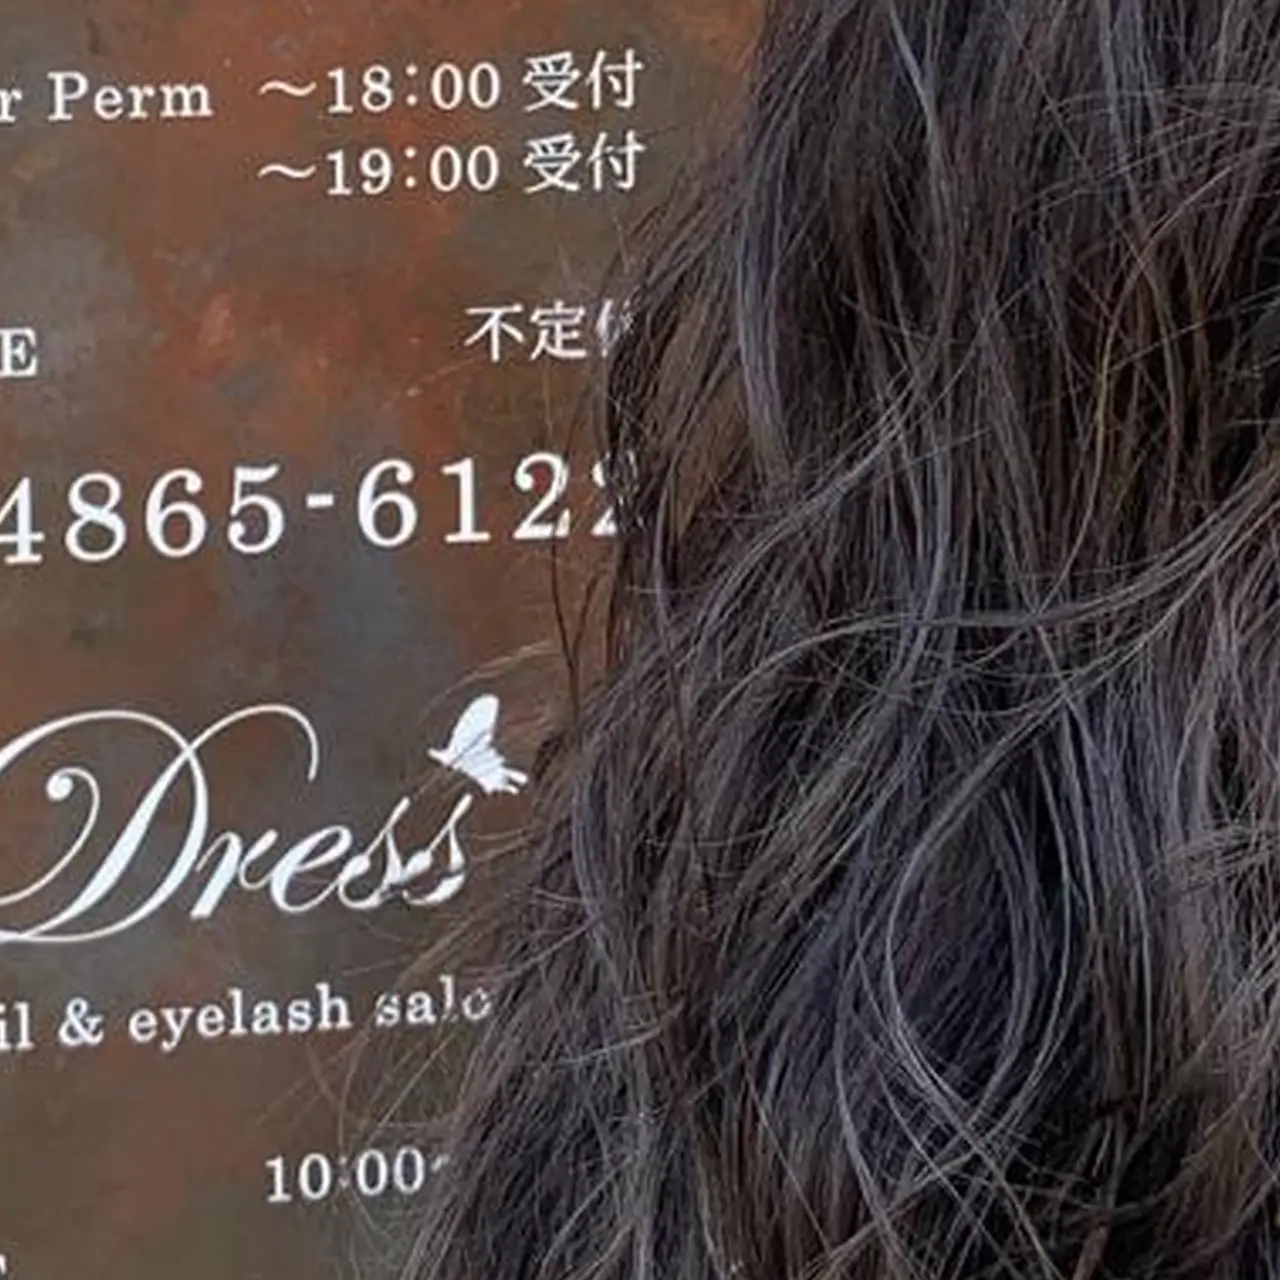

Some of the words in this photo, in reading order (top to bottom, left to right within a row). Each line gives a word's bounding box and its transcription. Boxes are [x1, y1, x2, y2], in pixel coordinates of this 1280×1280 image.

[46, 68, 214, 123] Perm
[521, 48, 645, 113] 受付
[521, 128, 647, 195] 受付
[56, 995, 106, 1048] &
[126, 980, 353, 1053] eyelash
[374, 973, 493, 1027] salo
[264, 1145, 451, 1204] 10:00
